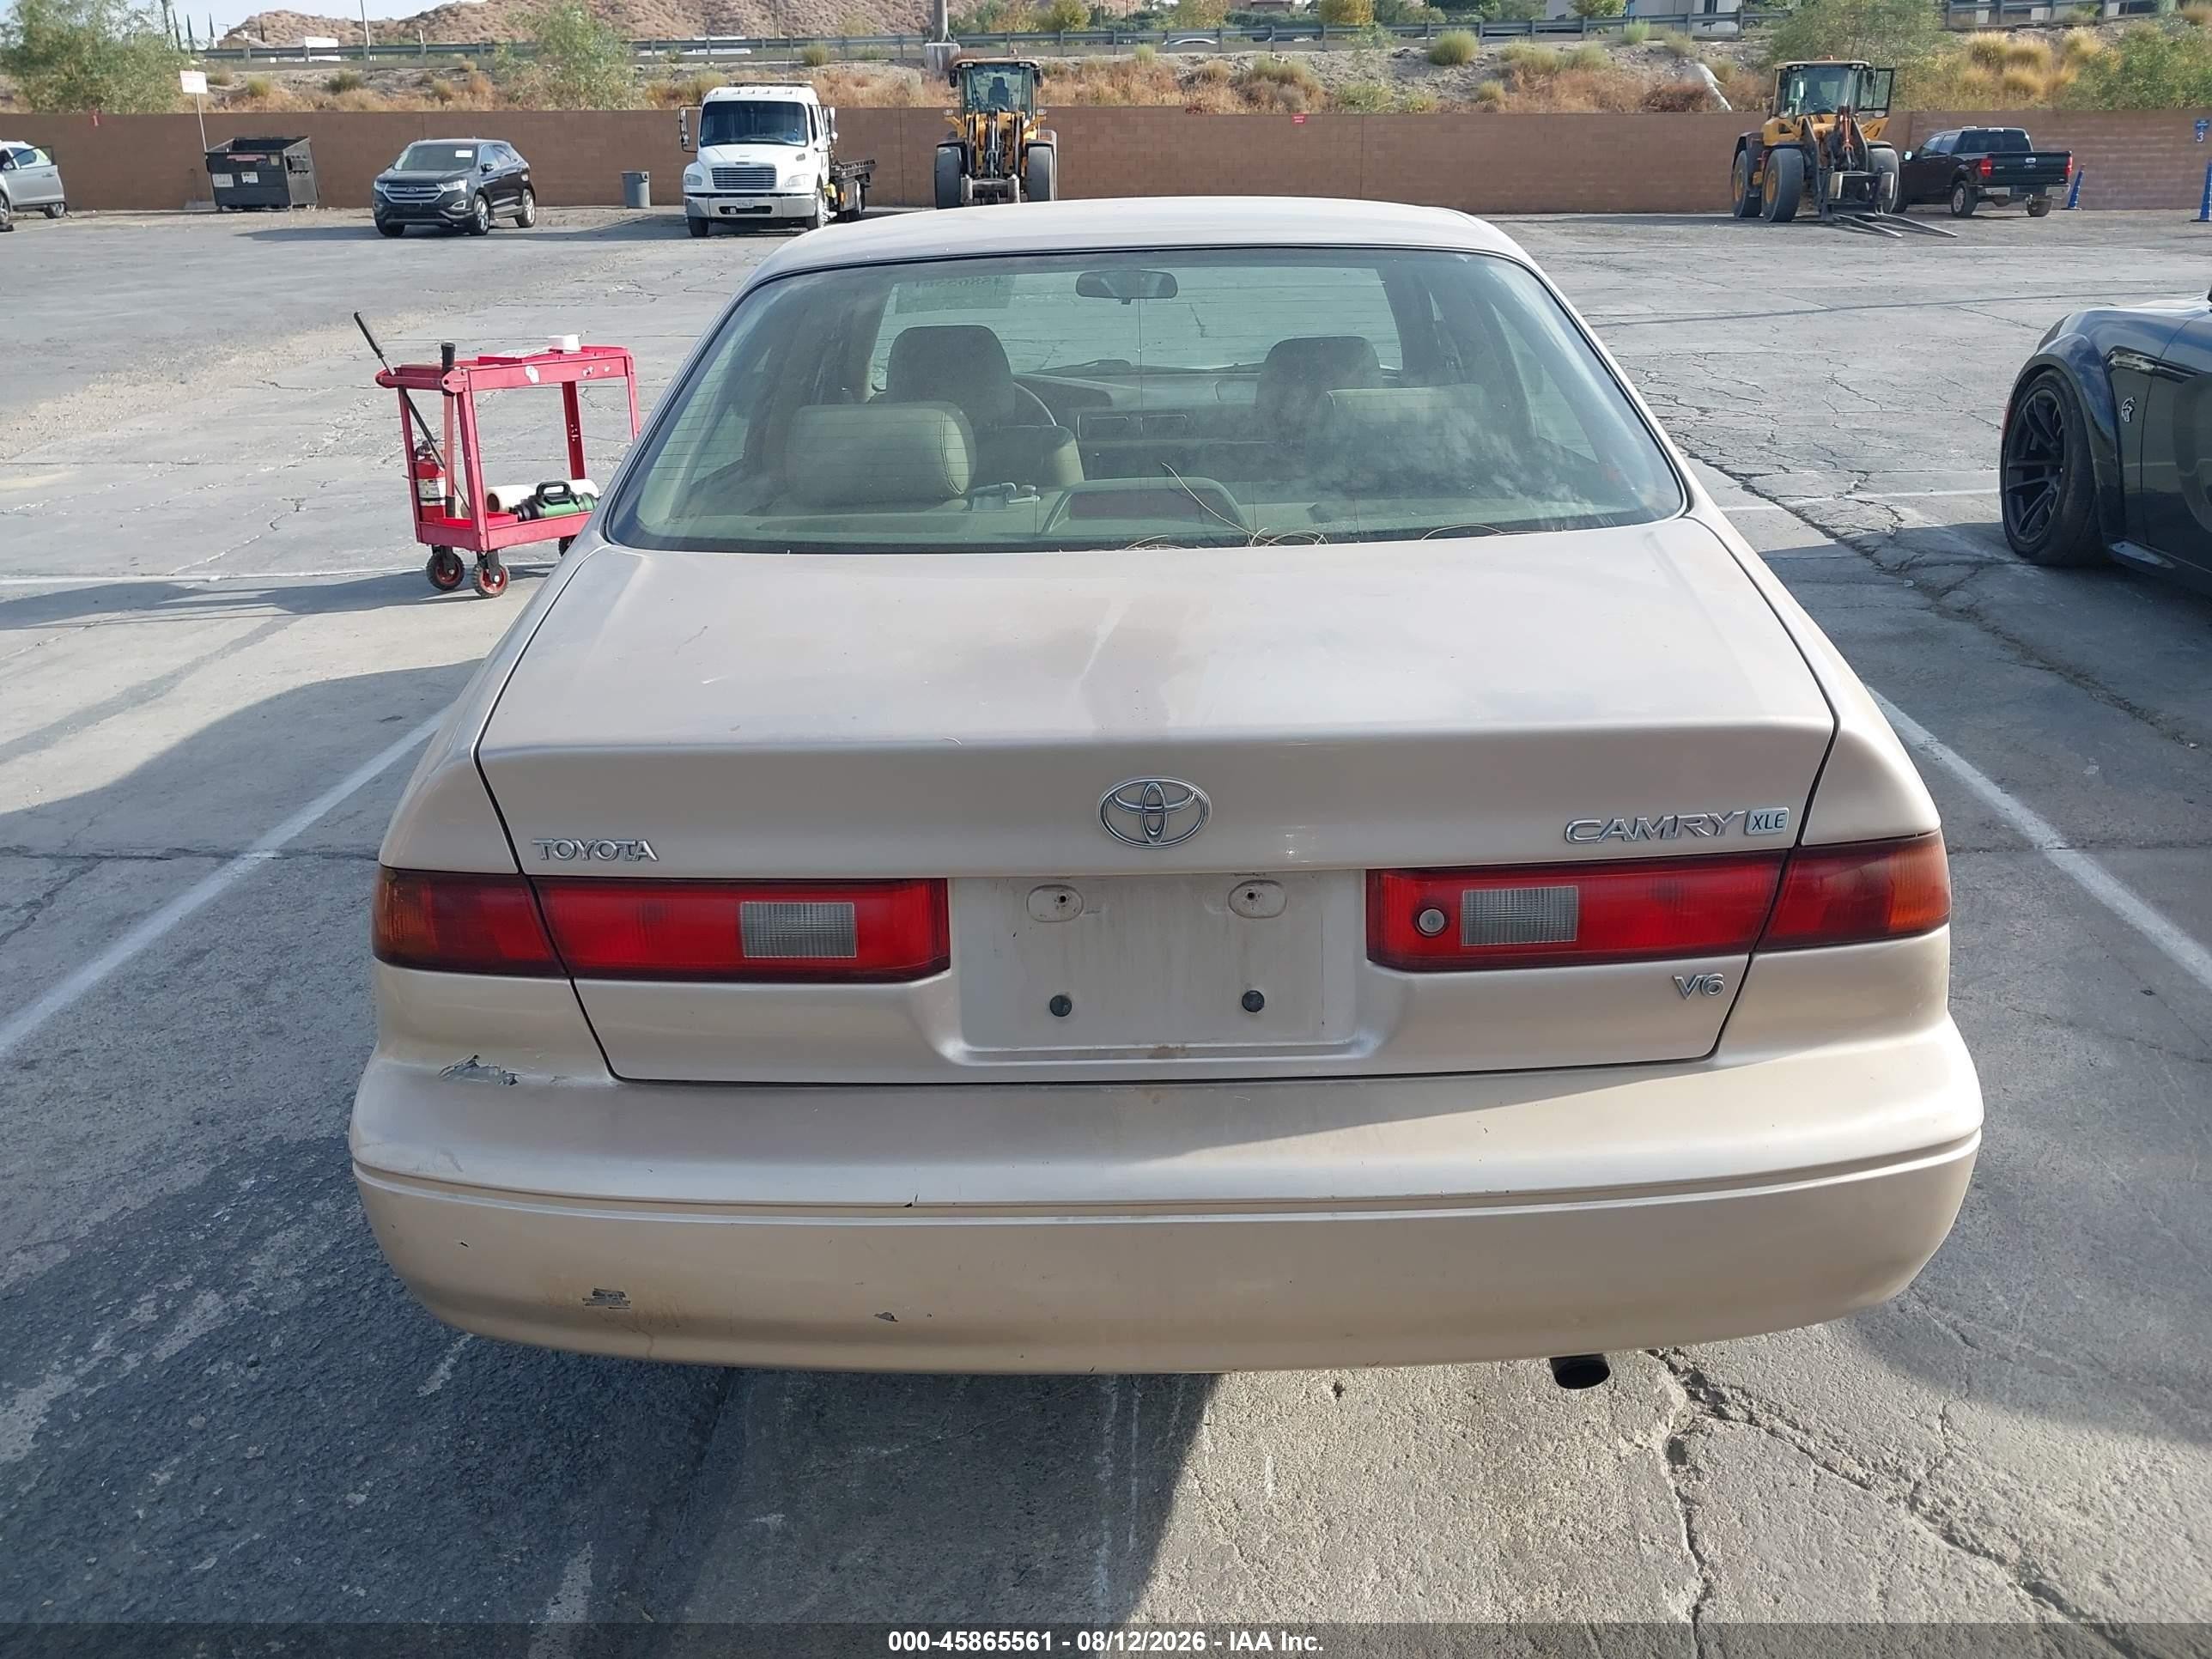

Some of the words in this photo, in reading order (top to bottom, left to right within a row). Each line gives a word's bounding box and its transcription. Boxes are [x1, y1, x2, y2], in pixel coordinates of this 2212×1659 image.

[2197, 131, 2204, 143] 3
[1565, 811, 1745, 843] CAMRY
[1752, 812, 1786, 831] XLE
[532, 838, 659, 861] TOYOTA
[1673, 973, 1724, 1000] V6
